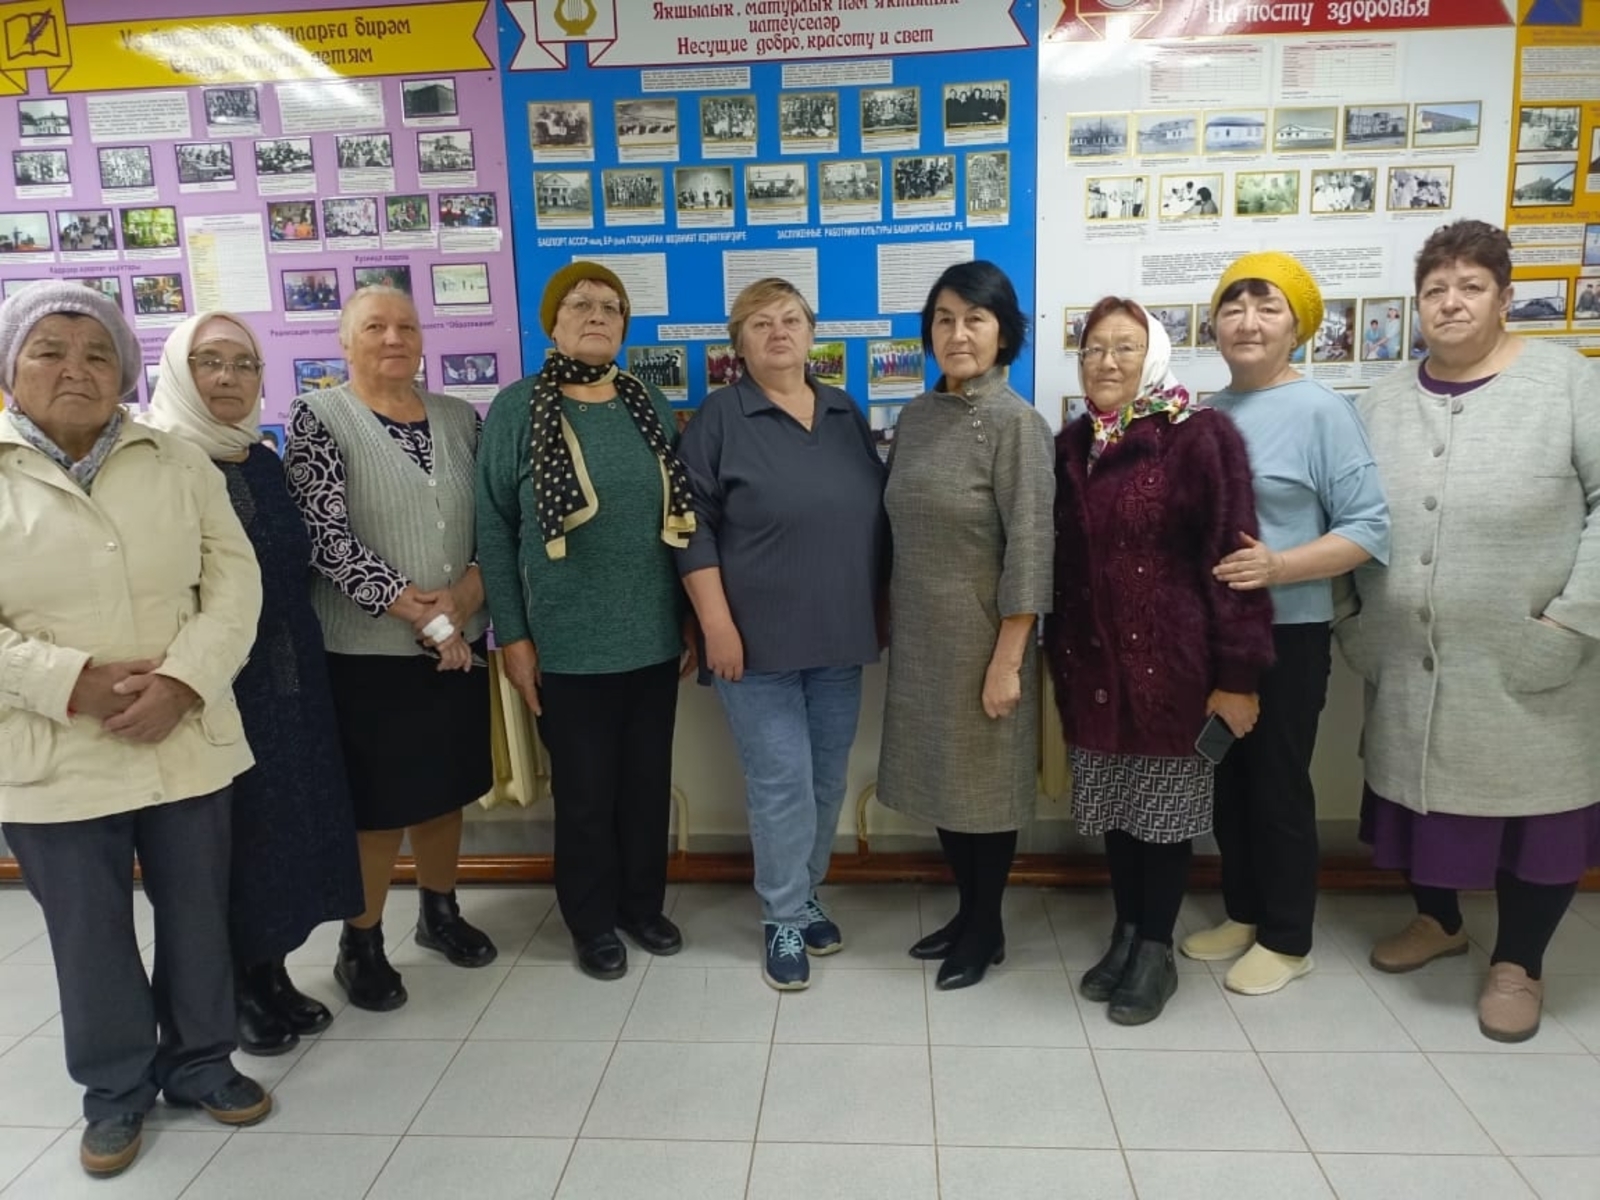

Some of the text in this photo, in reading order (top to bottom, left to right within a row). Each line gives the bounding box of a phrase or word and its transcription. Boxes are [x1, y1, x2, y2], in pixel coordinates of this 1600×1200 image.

[1207, 0, 1430, 26] На посту здоровья
[354, 16, 412, 39] бирәм
[677, 36, 749, 58] Несущие
[807, 32, 875, 51] красоту
[880, 31, 889, 45] и
[894, 28, 934, 44] свет
